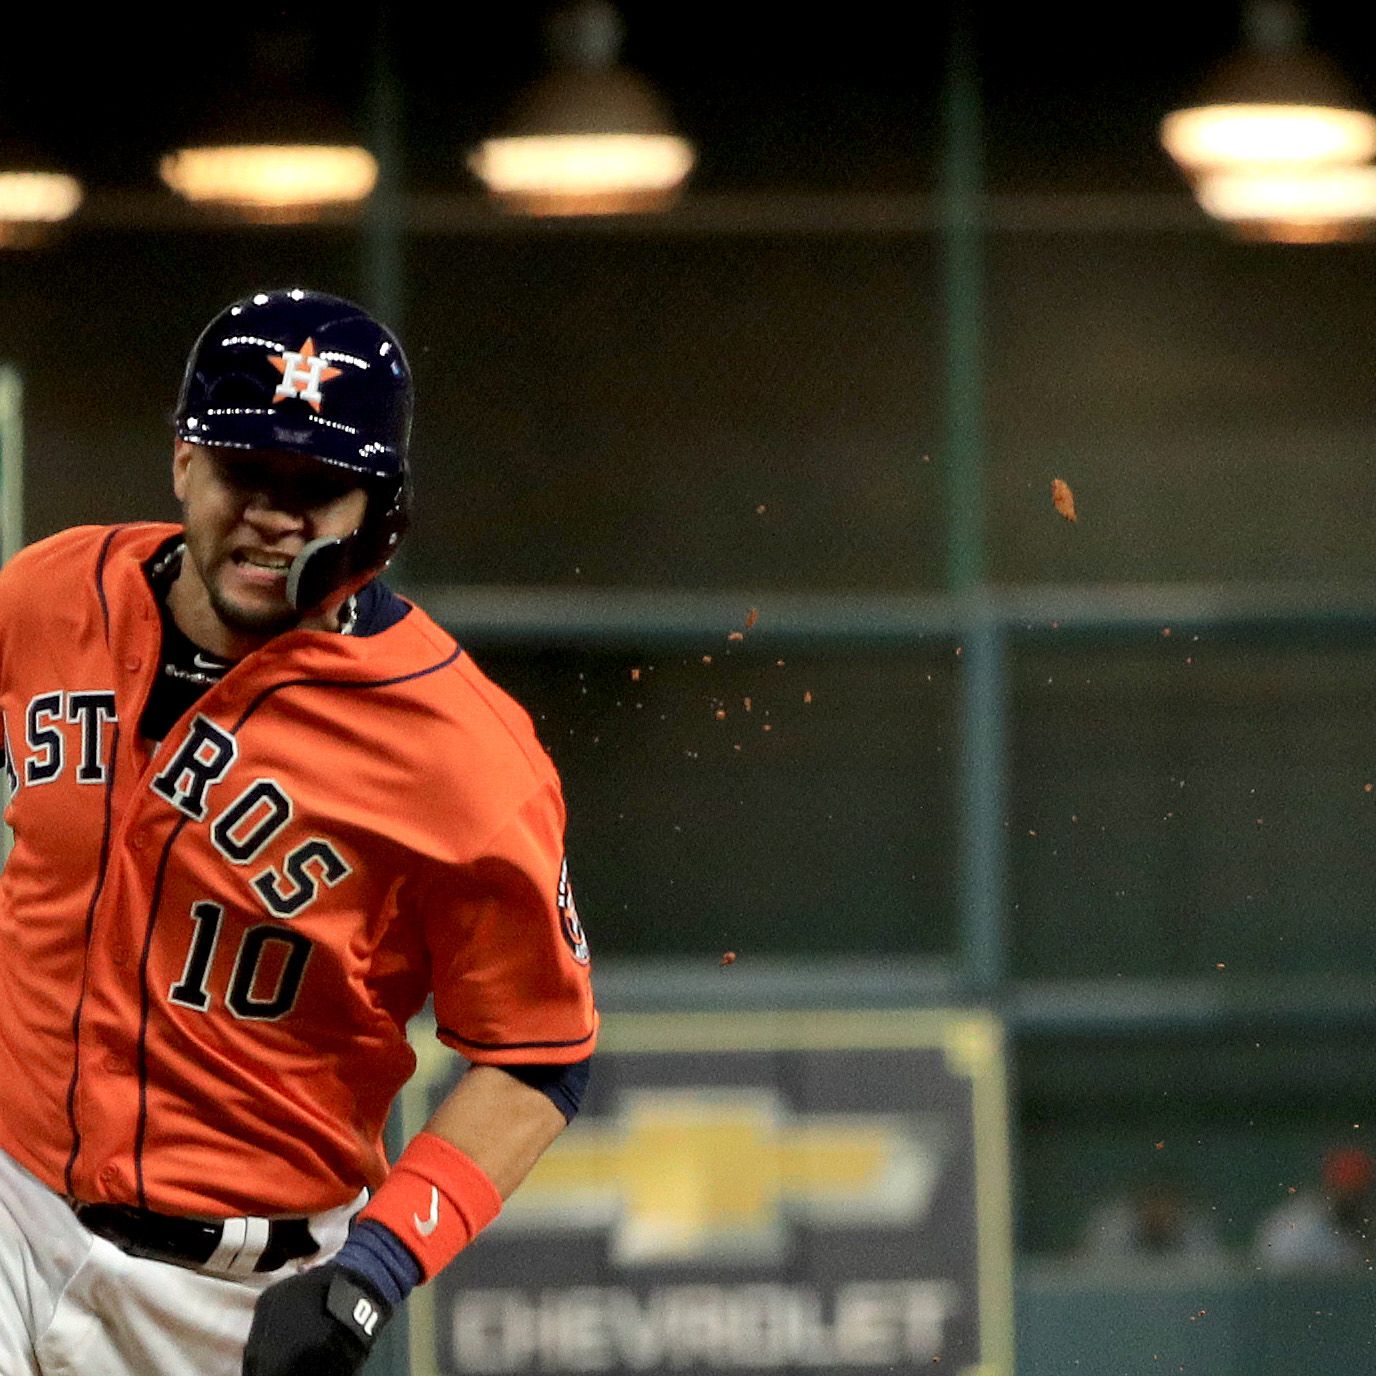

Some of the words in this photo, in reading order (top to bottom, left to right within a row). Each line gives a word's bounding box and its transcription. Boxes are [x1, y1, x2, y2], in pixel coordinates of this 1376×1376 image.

[275, 350, 330, 401] H
[167, 901, 313, 1021] 10
[453, 1282, 952, 1374] CHEVROLET
